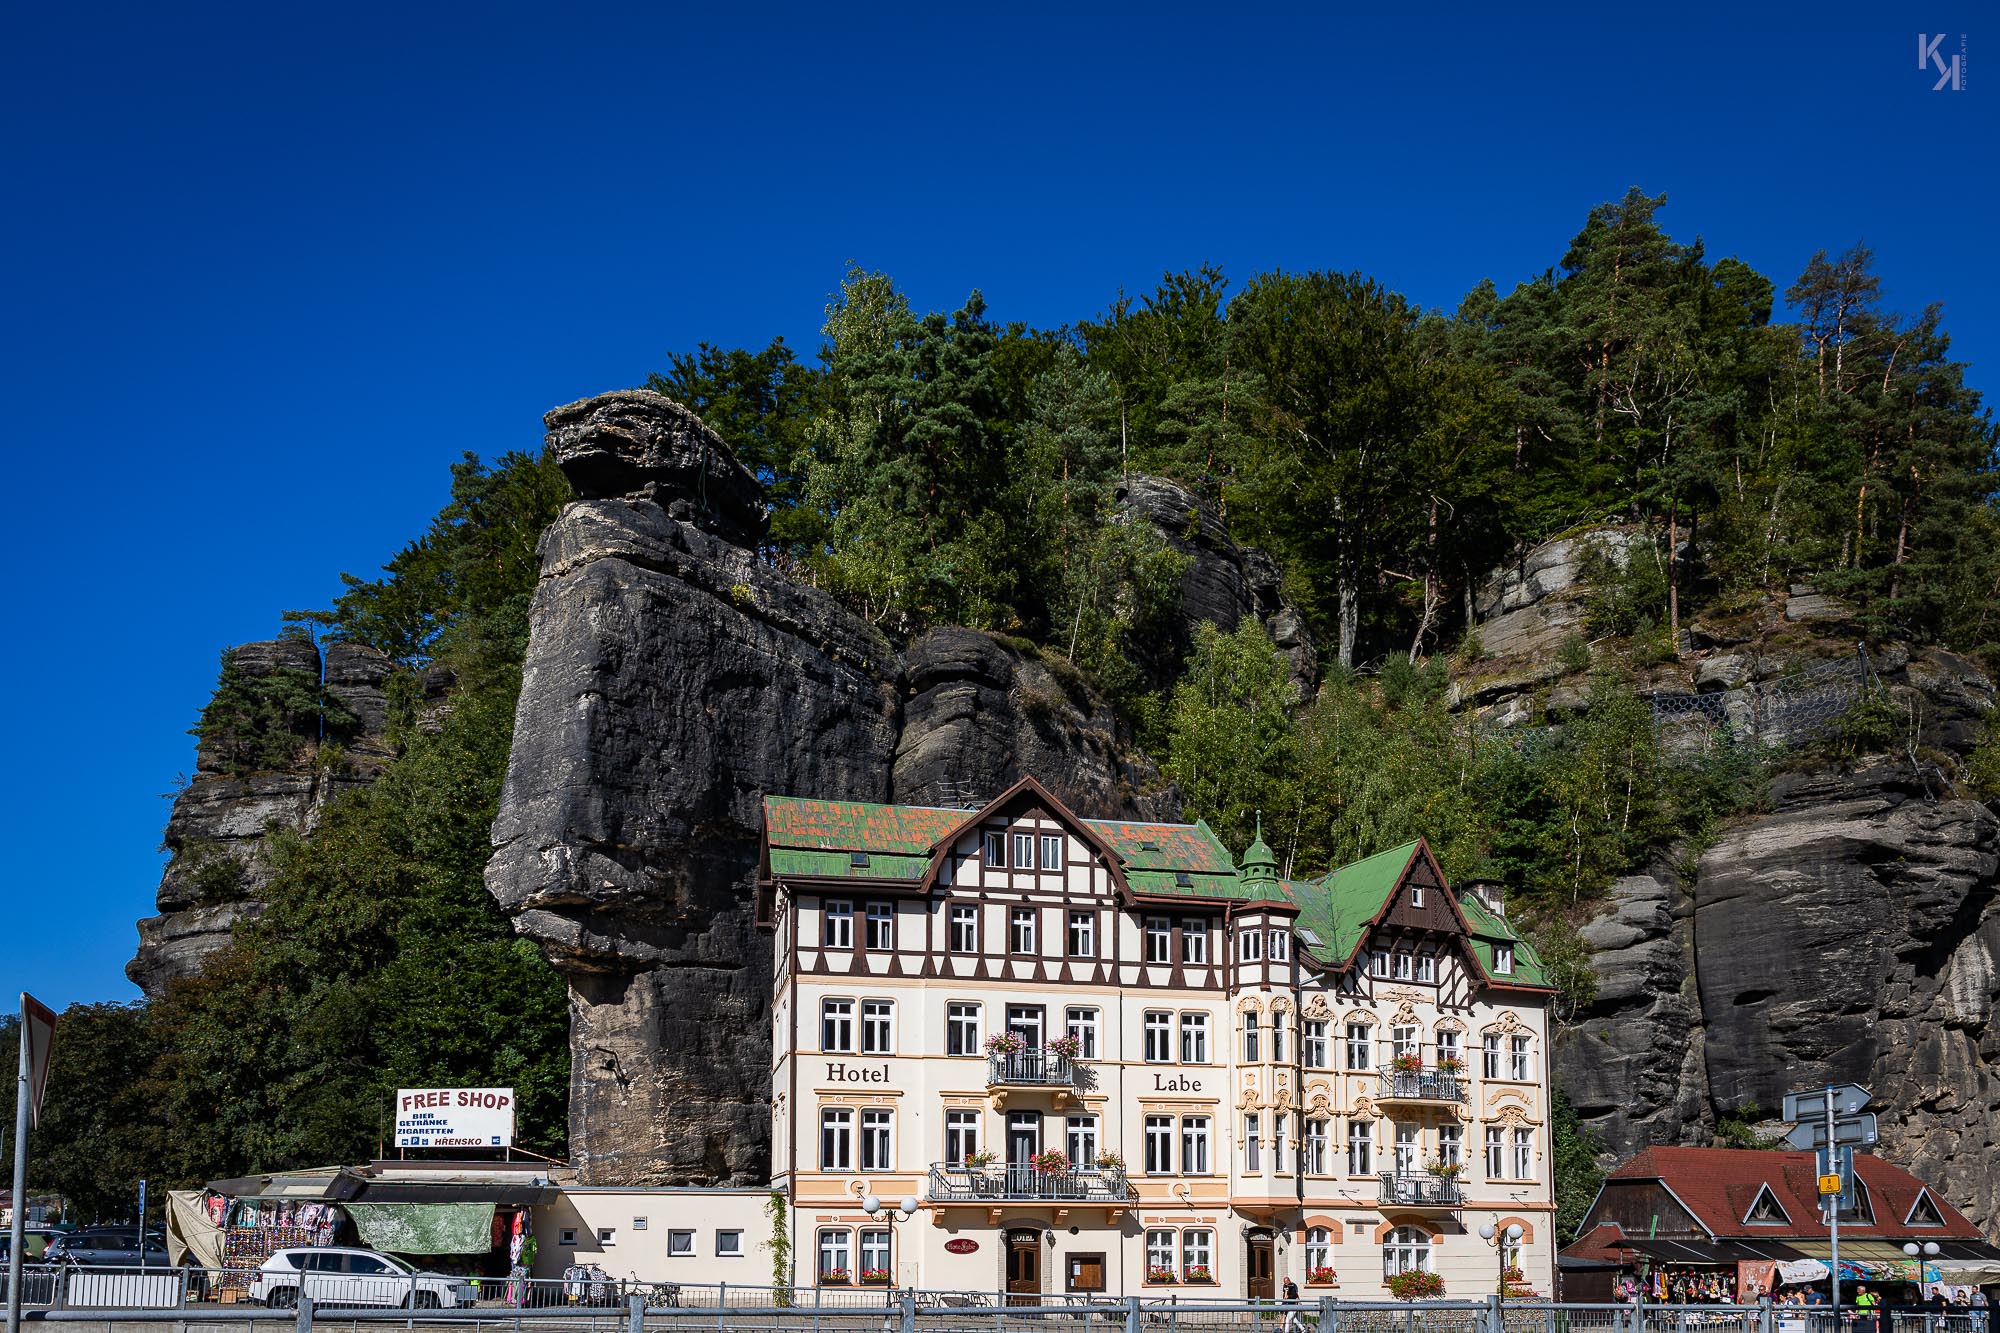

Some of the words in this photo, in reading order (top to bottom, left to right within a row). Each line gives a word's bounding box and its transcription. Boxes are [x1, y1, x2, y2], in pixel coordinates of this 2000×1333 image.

[826, 1063, 890, 1083] Hotel
[1154, 1073, 1202, 1092] Labe
[402, 1091, 450, 1112] FREE
[457, 1091, 510, 1110] SHOP
[399, 1119, 448, 1127] GETRÄNKE
[434, 1136, 482, 1145] HŘENSKO
